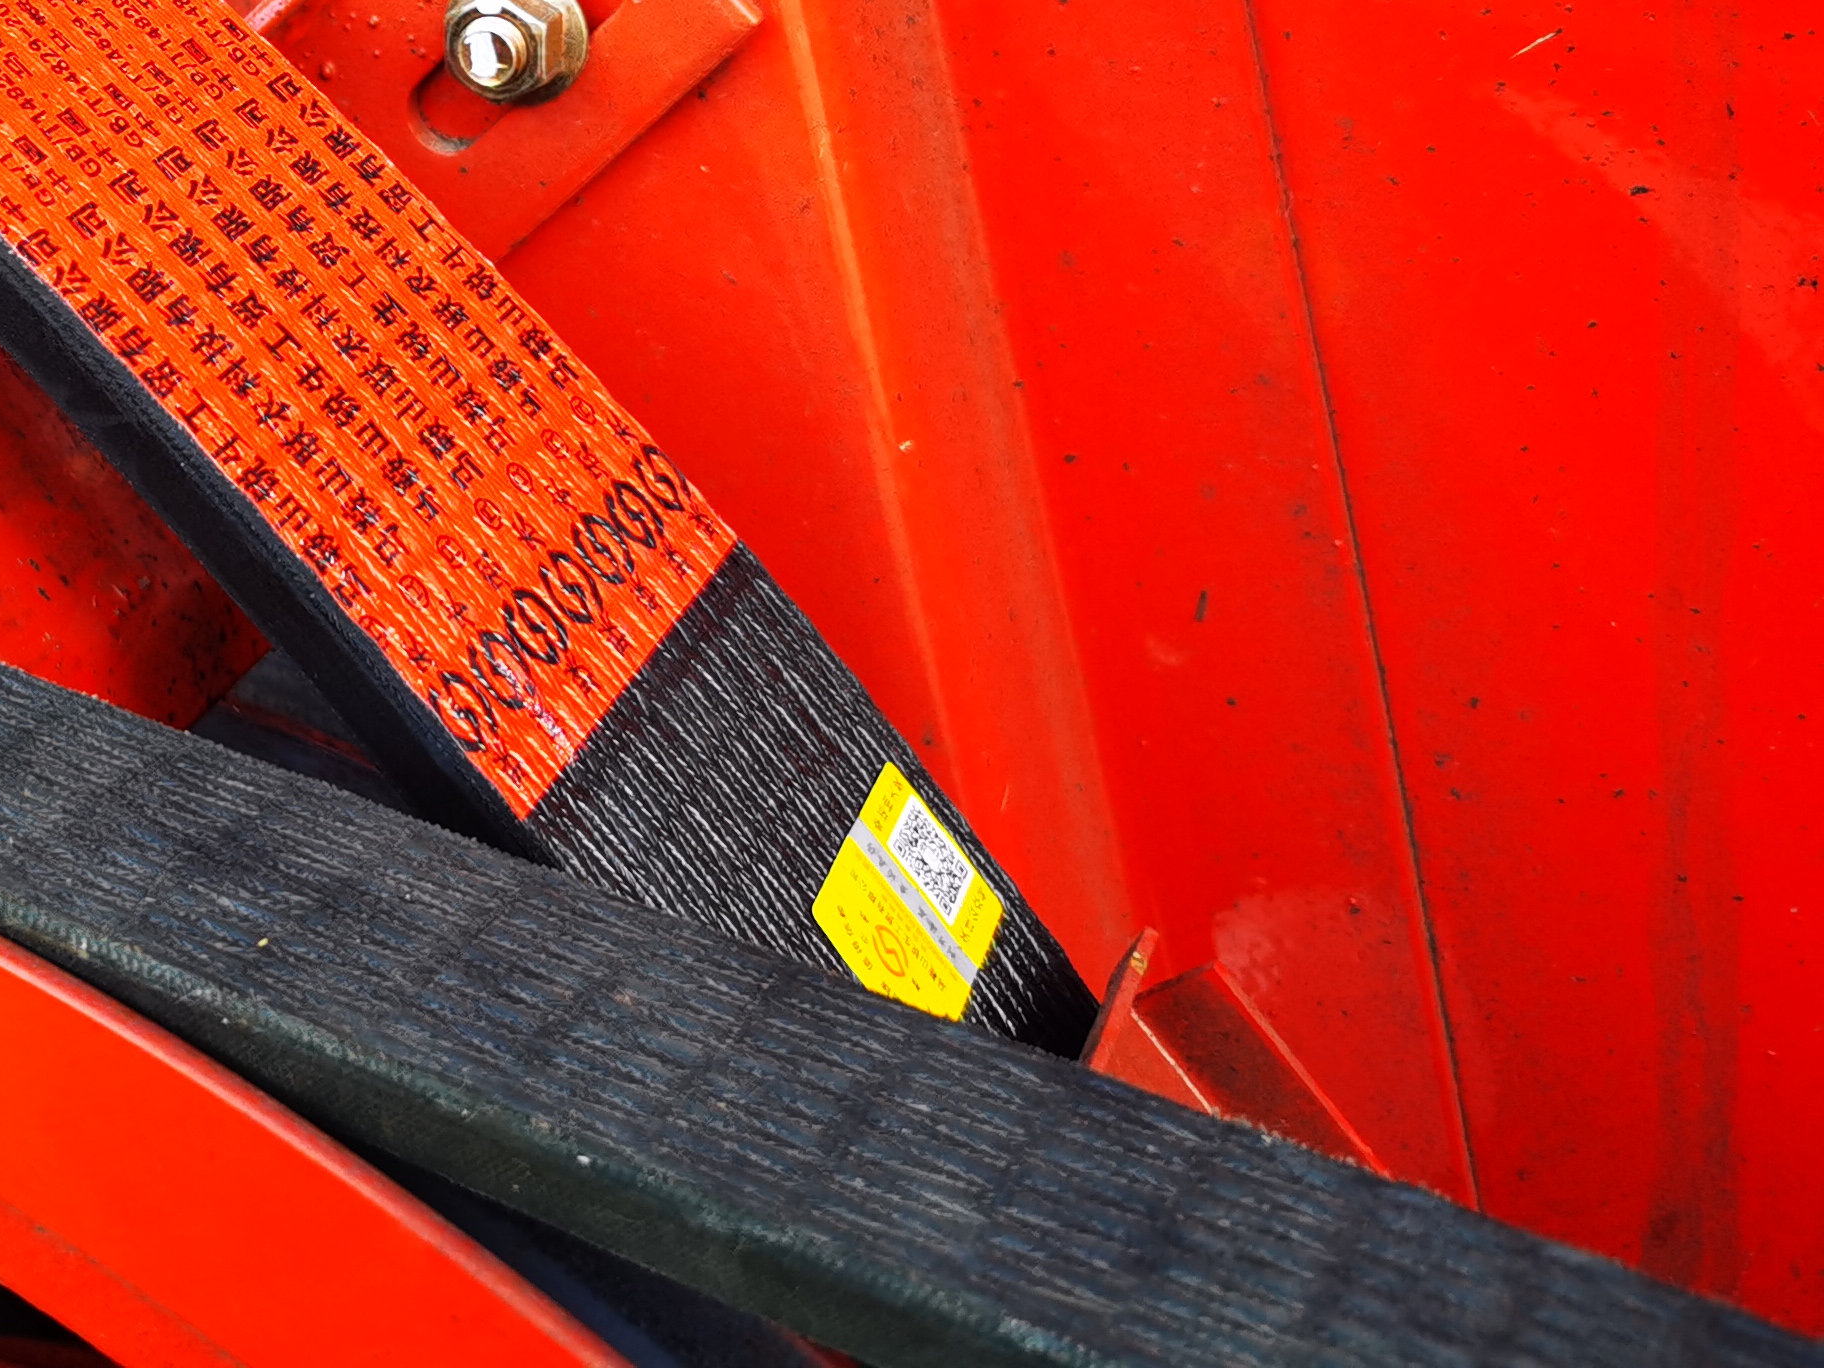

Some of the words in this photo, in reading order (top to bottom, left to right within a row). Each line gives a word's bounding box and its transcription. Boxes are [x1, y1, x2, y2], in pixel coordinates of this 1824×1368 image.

[68, 202, 400, 568] 马鞍山联农科技有限公司
[109, 169, 440, 522] 马鞍山锐生工贸有限公司
[153, 146, 484, 491] 马鞍山联农科技有限公司
[193, 118, 507, 456] 马鞍山锐生工贸有限公司
[232, 98, 542, 418] 马鞍山联农科技有限公司
[265, 73, 580, 390] 马鞍山锐生工贸有限公司
[15, 230, 372, 609] 马鞍山锐生工贸有限公司
